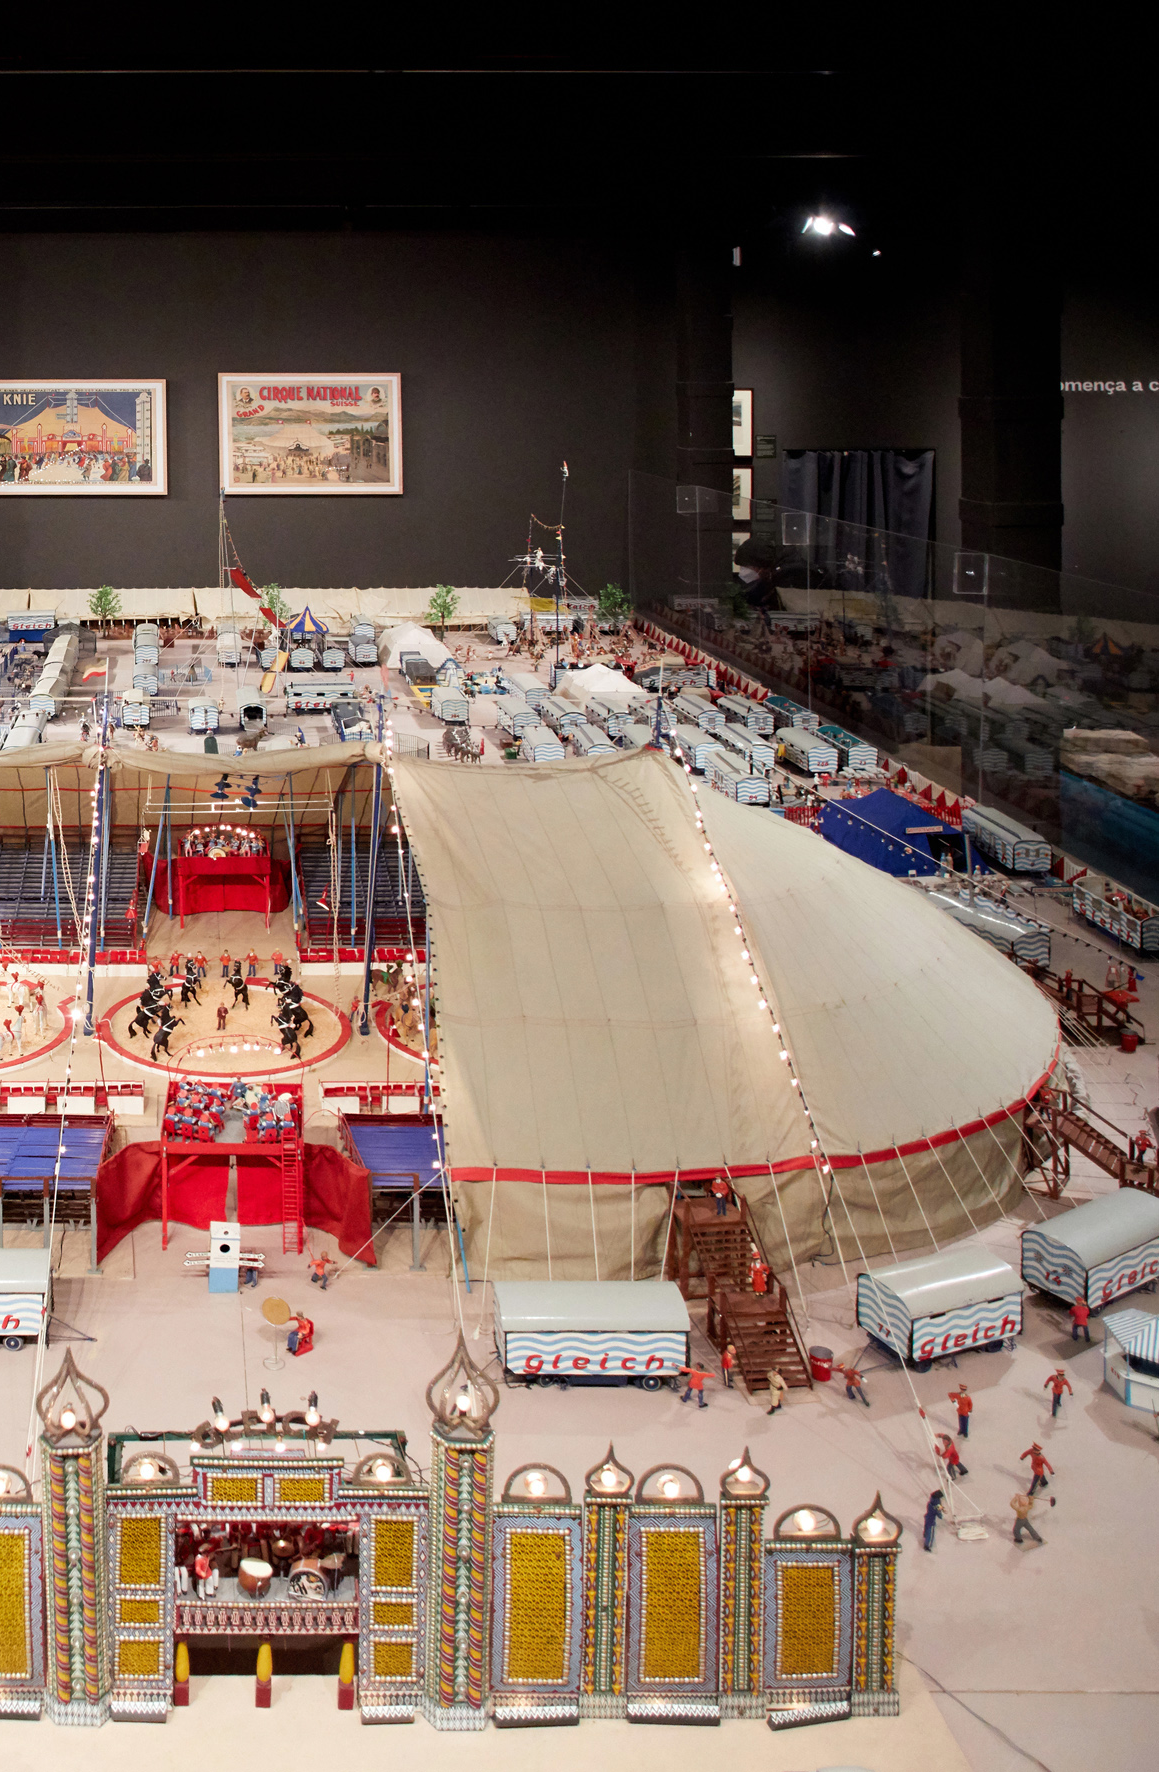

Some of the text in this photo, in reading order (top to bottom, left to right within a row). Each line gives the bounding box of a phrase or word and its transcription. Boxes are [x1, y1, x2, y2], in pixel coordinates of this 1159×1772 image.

[1132, 381, 1144, 391] a
[3, 393, 36, 406] KNIE
[259, 386, 362, 403] CIRQUE NATIONAL
[236, 404, 265, 418] GRAND
[1045, 1271, 1061, 1286] 14
